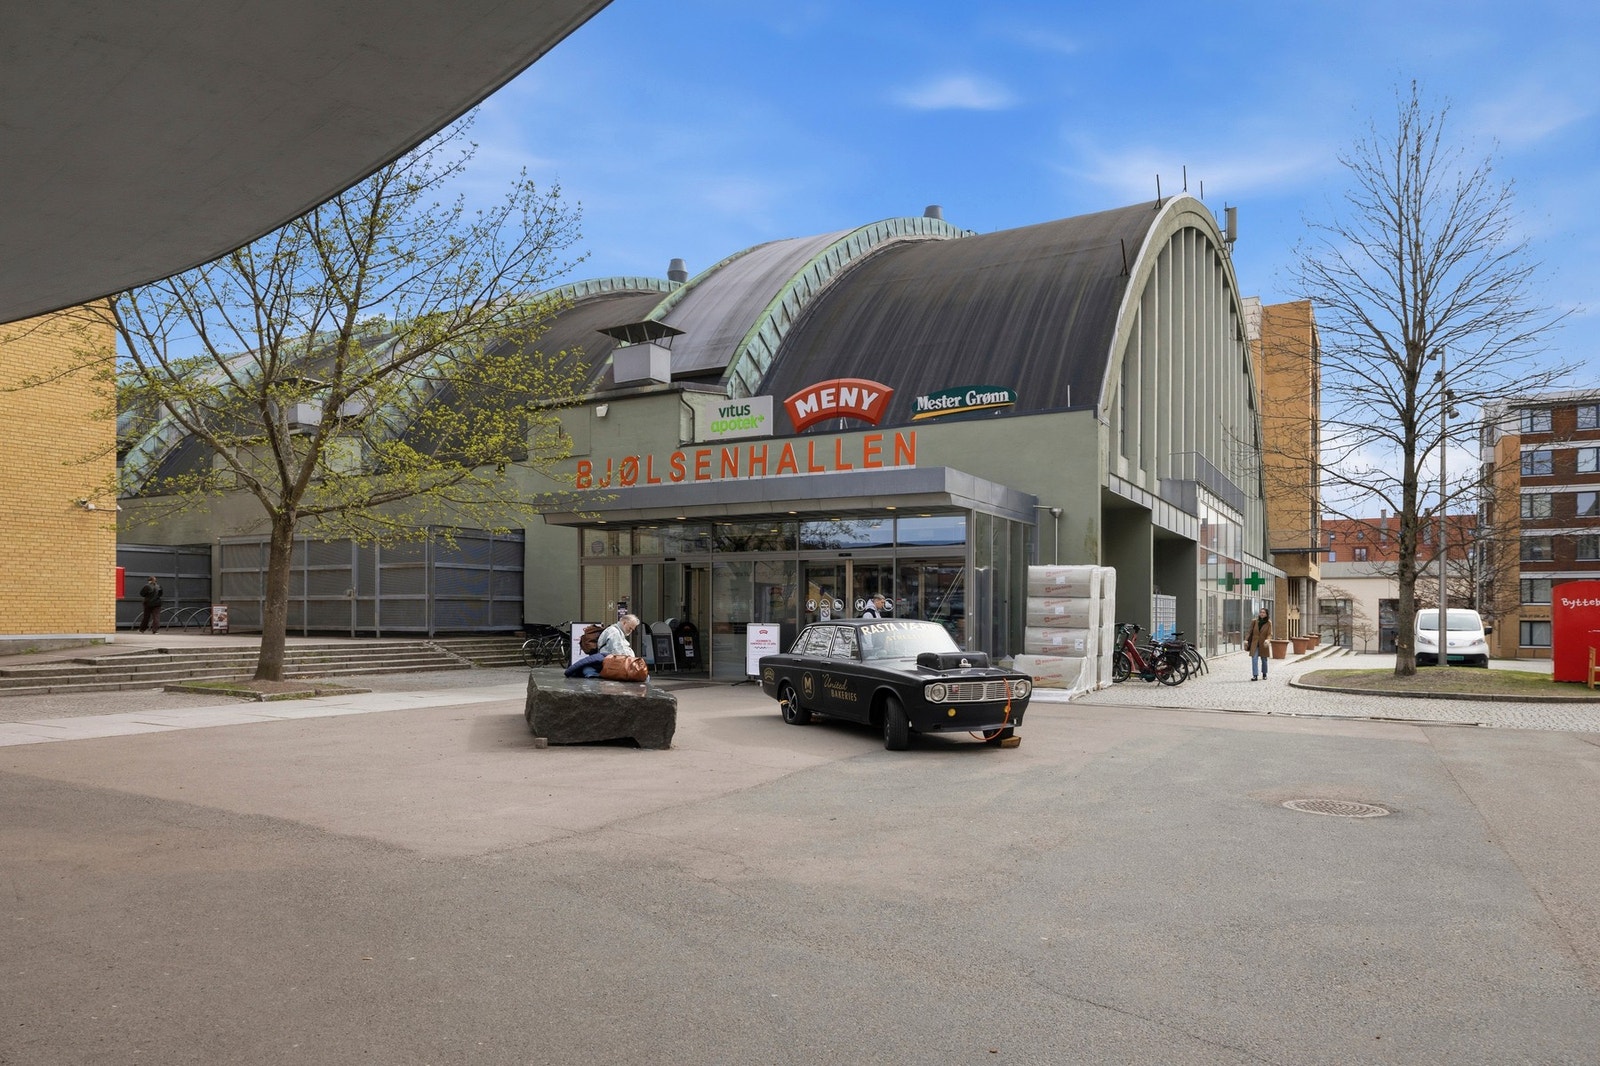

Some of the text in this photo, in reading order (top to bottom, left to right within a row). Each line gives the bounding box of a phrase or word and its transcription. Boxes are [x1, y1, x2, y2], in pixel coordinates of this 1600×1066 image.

[794, 386, 879, 419] MENY
[916, 390, 1010, 411] Mester Grønn
[718, 404, 751, 418] vitus
[576, 431, 916, 489] BJØLSENHALLEN
[860, 622, 898, 636] RASTA
[830, 689, 857, 701] BAKERIES
